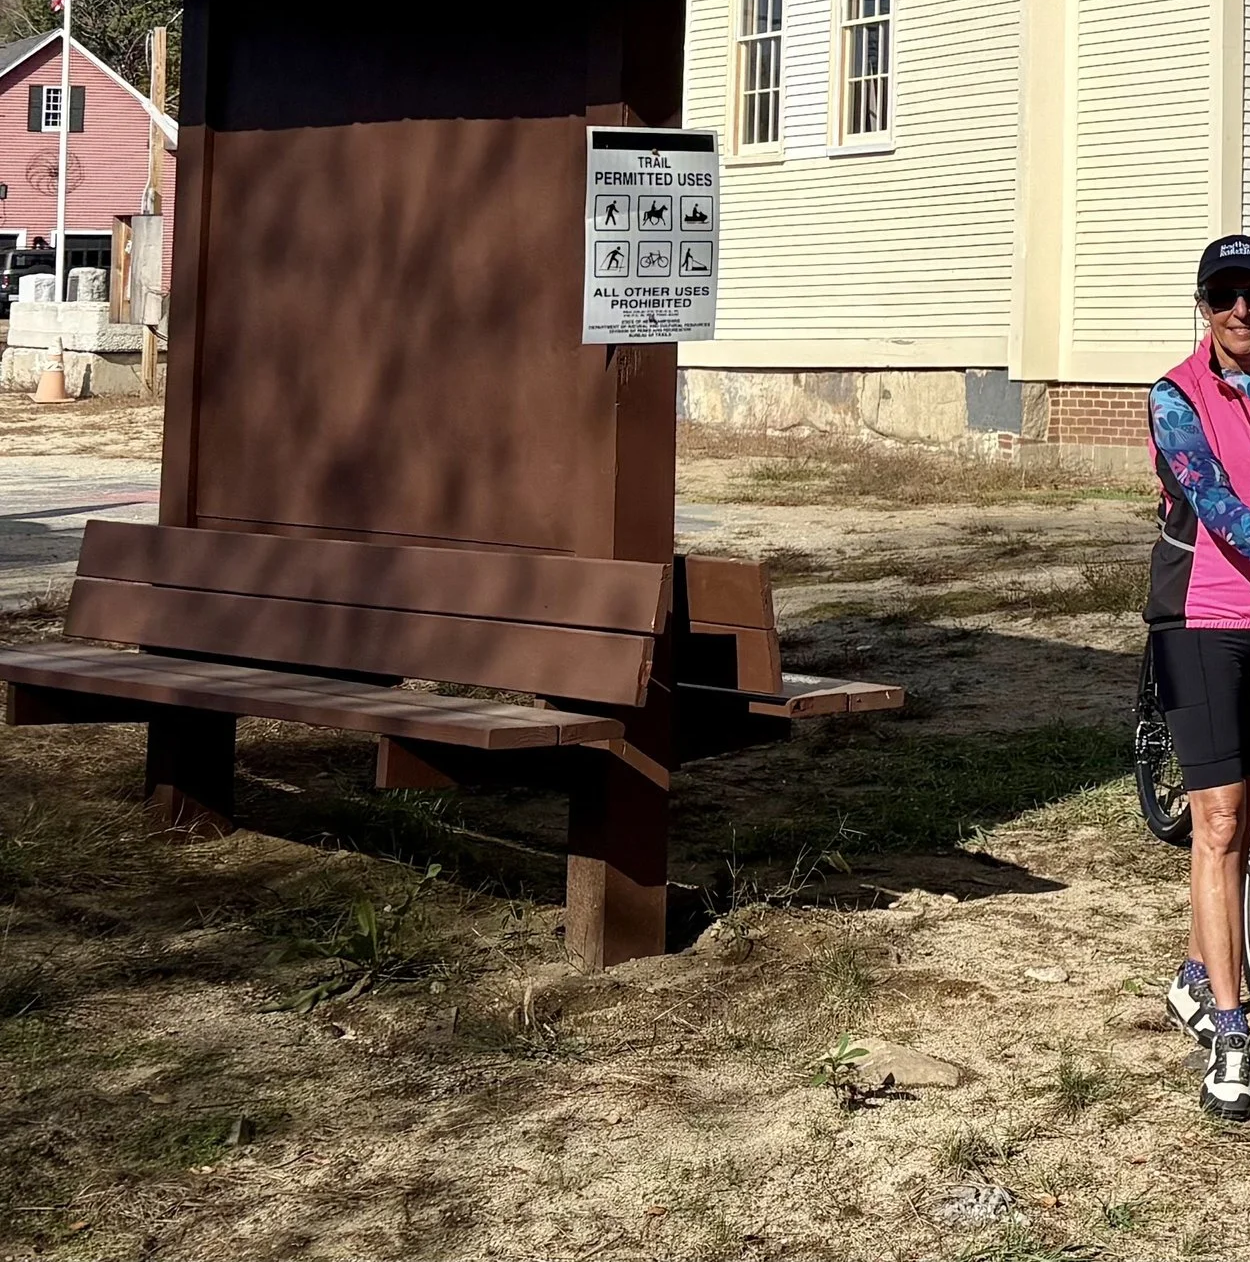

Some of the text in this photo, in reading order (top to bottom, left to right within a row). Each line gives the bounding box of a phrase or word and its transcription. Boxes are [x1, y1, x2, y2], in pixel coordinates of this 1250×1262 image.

[638, 156, 671, 169] TRAIL
[595, 171, 713, 187] PERMITTED USES
[593, 286, 710, 298] ALL OTHER USES
[611, 298, 692, 309] PROHIBITED
